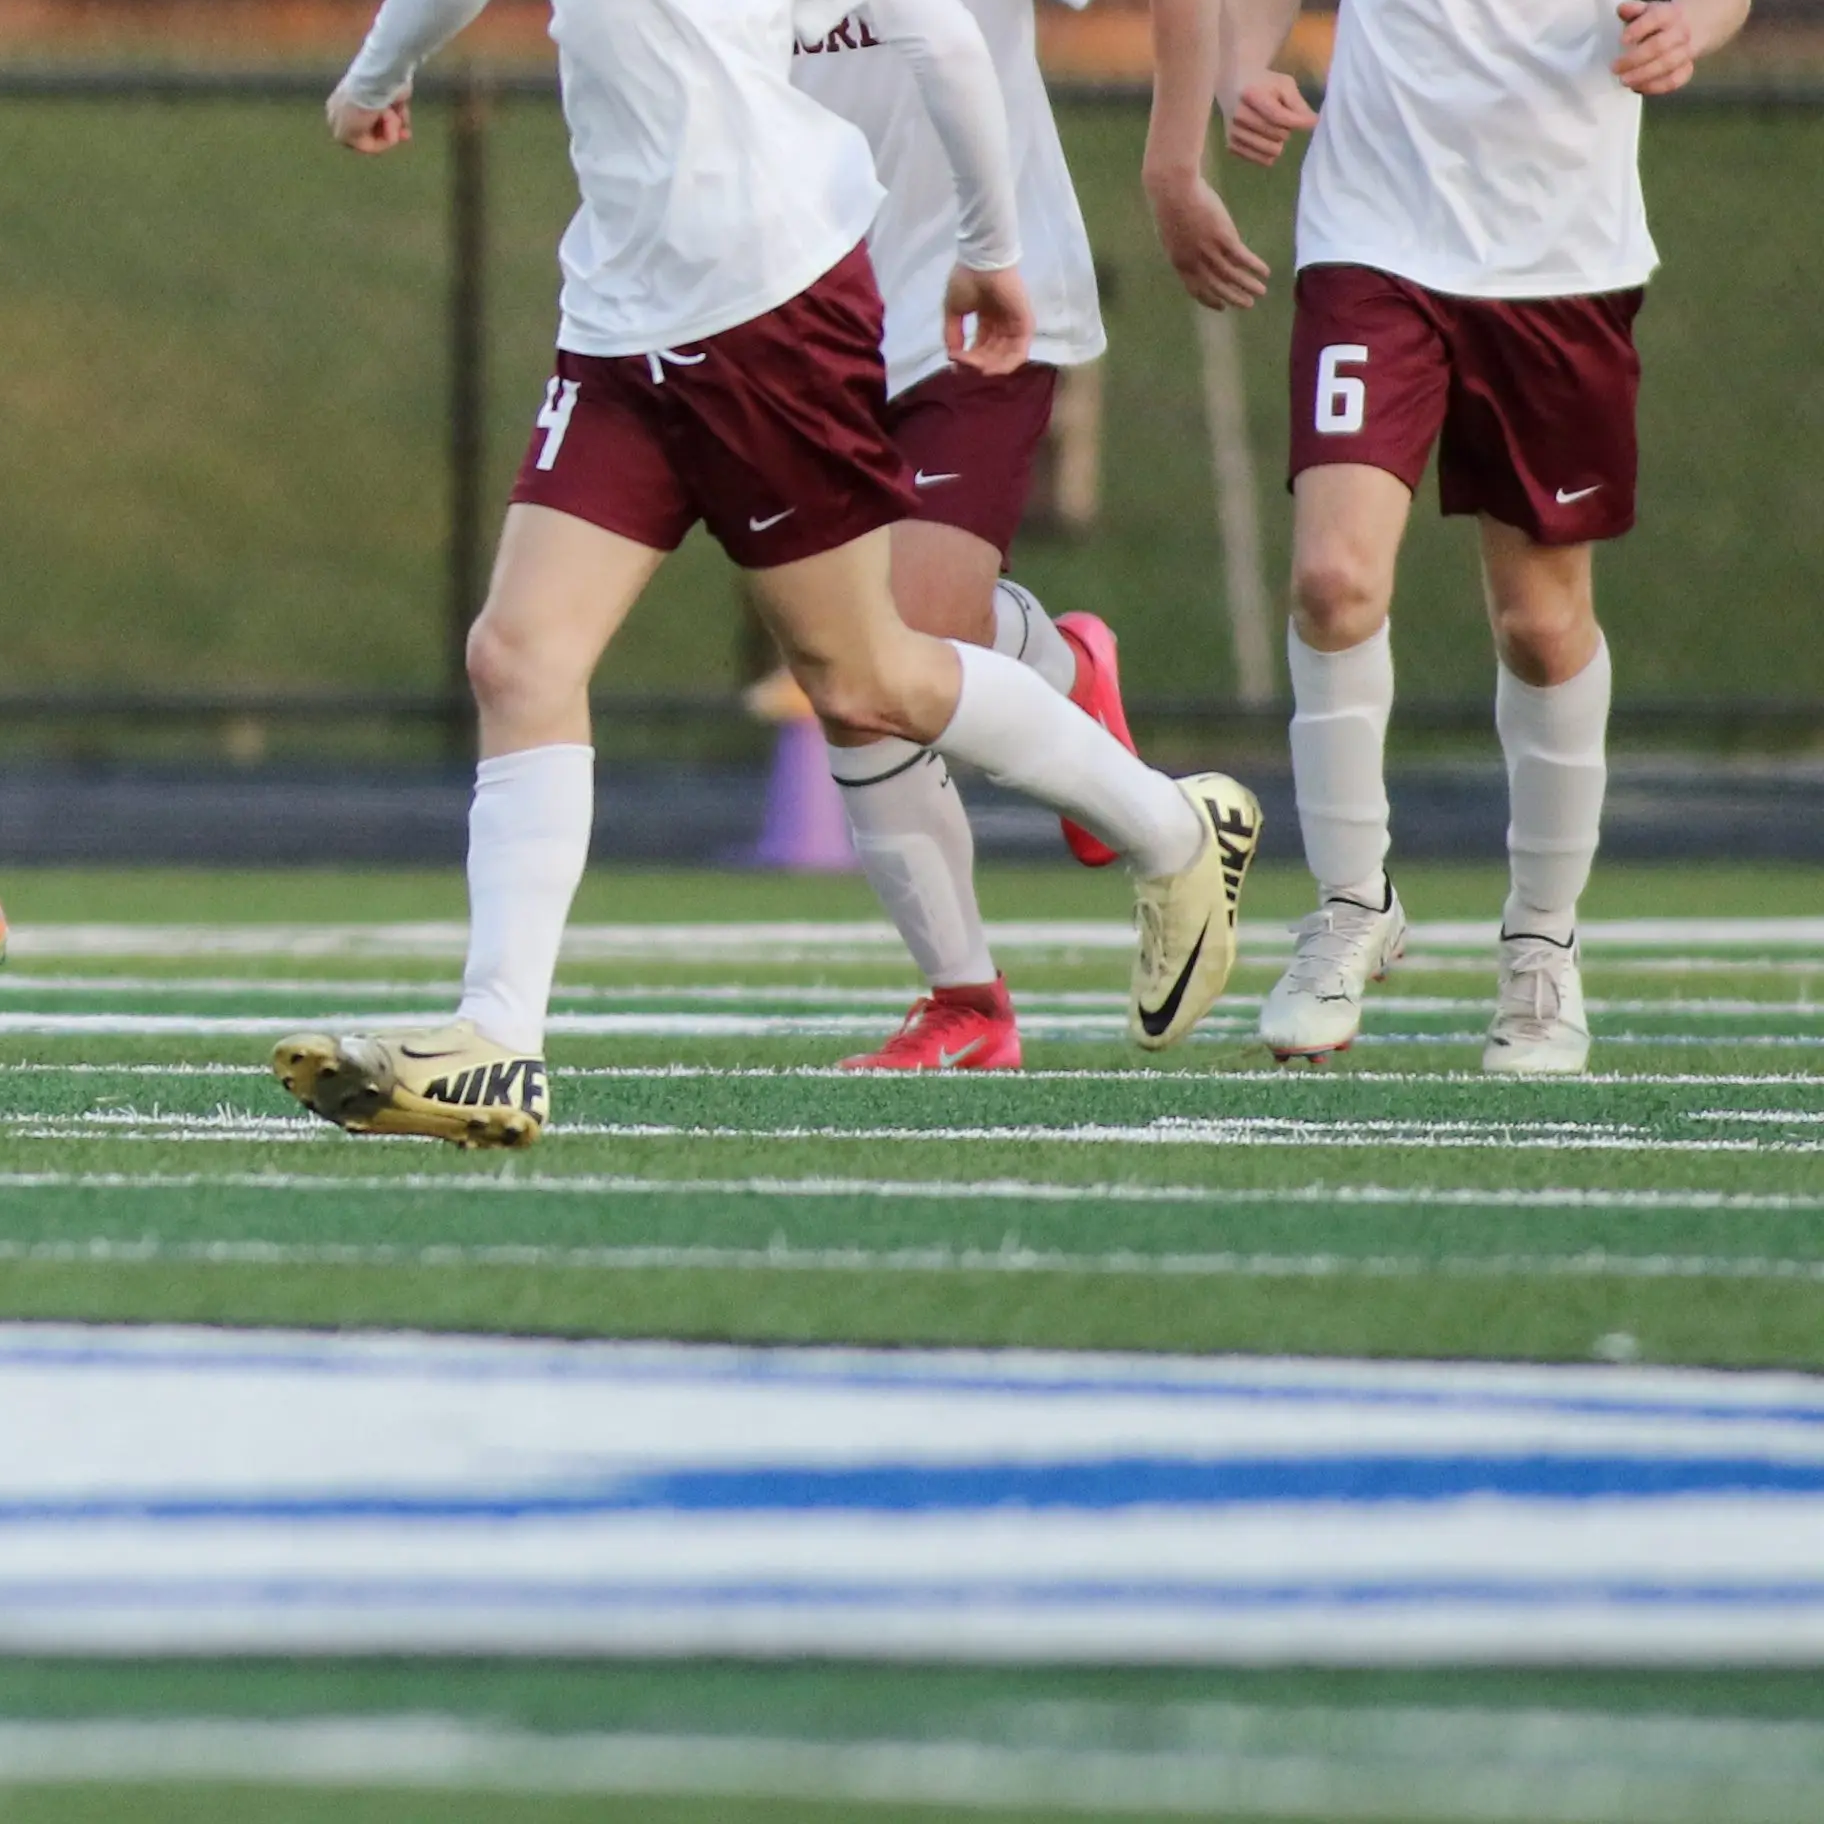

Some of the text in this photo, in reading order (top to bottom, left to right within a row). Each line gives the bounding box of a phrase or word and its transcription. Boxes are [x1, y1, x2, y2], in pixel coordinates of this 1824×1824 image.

[536, 375, 582, 470] 4
[1315, 344, 1368, 433] 6
[423, 1059, 546, 1125] NIKE
